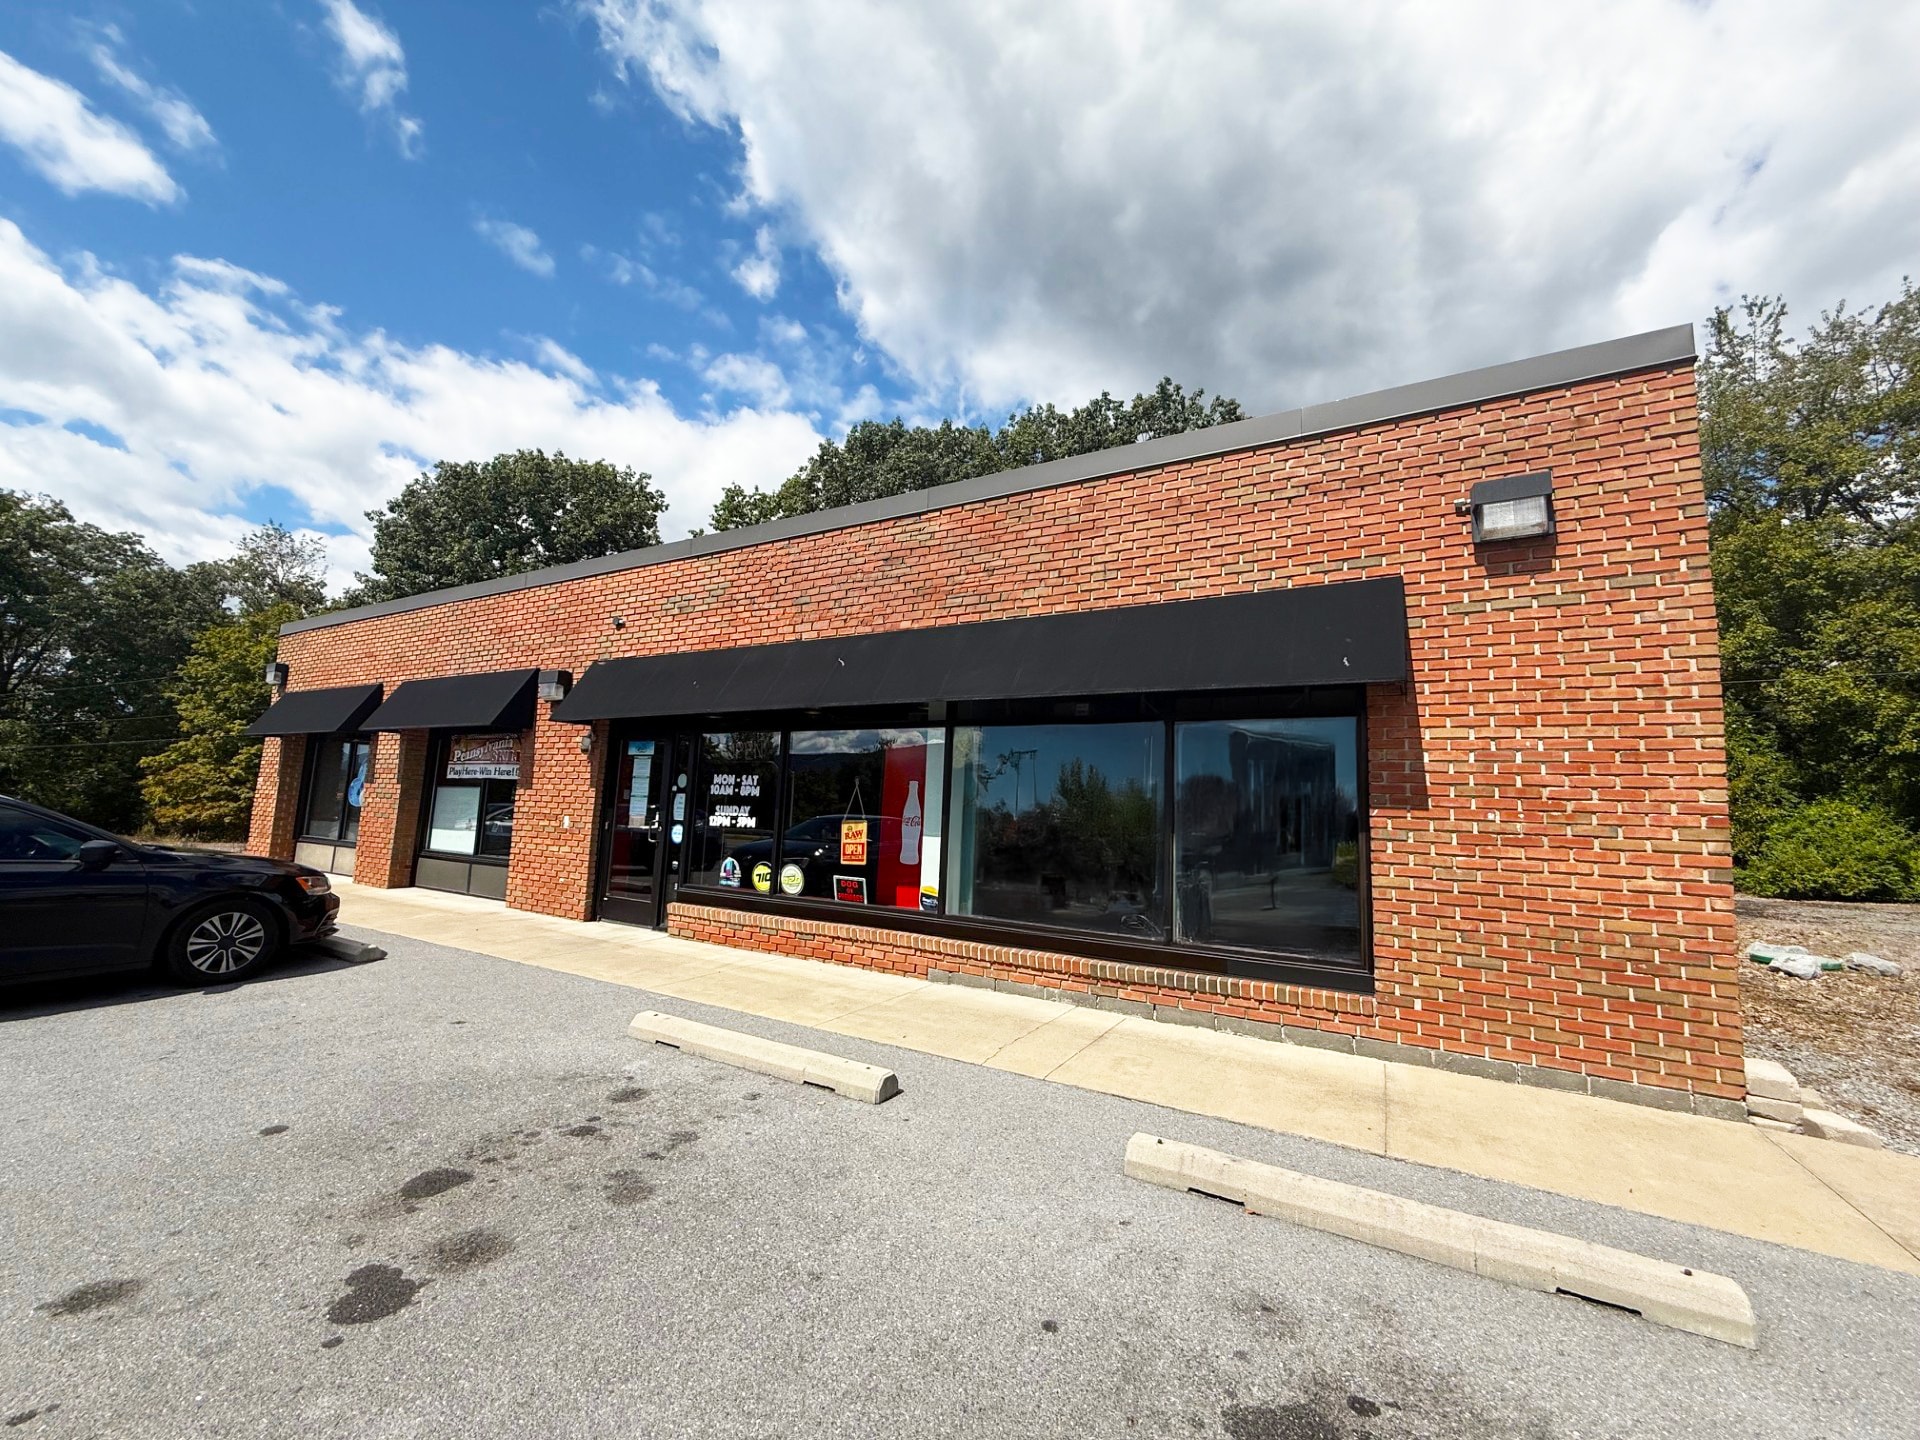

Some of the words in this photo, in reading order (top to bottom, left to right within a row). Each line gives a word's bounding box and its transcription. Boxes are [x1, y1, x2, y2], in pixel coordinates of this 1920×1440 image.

[453, 736, 513, 761] Pennsylvania
[713, 774, 735, 785] MON
[741, 774, 759, 786] SAT
[710, 784, 734, 796] 10AM
[715, 805, 750, 816] SUNDAY
[709, 815, 731, 827] 12PM
[844, 829, 864, 841] RAW
[845, 843, 863, 855] OPEN
[840, 880, 859, 889] DOG
